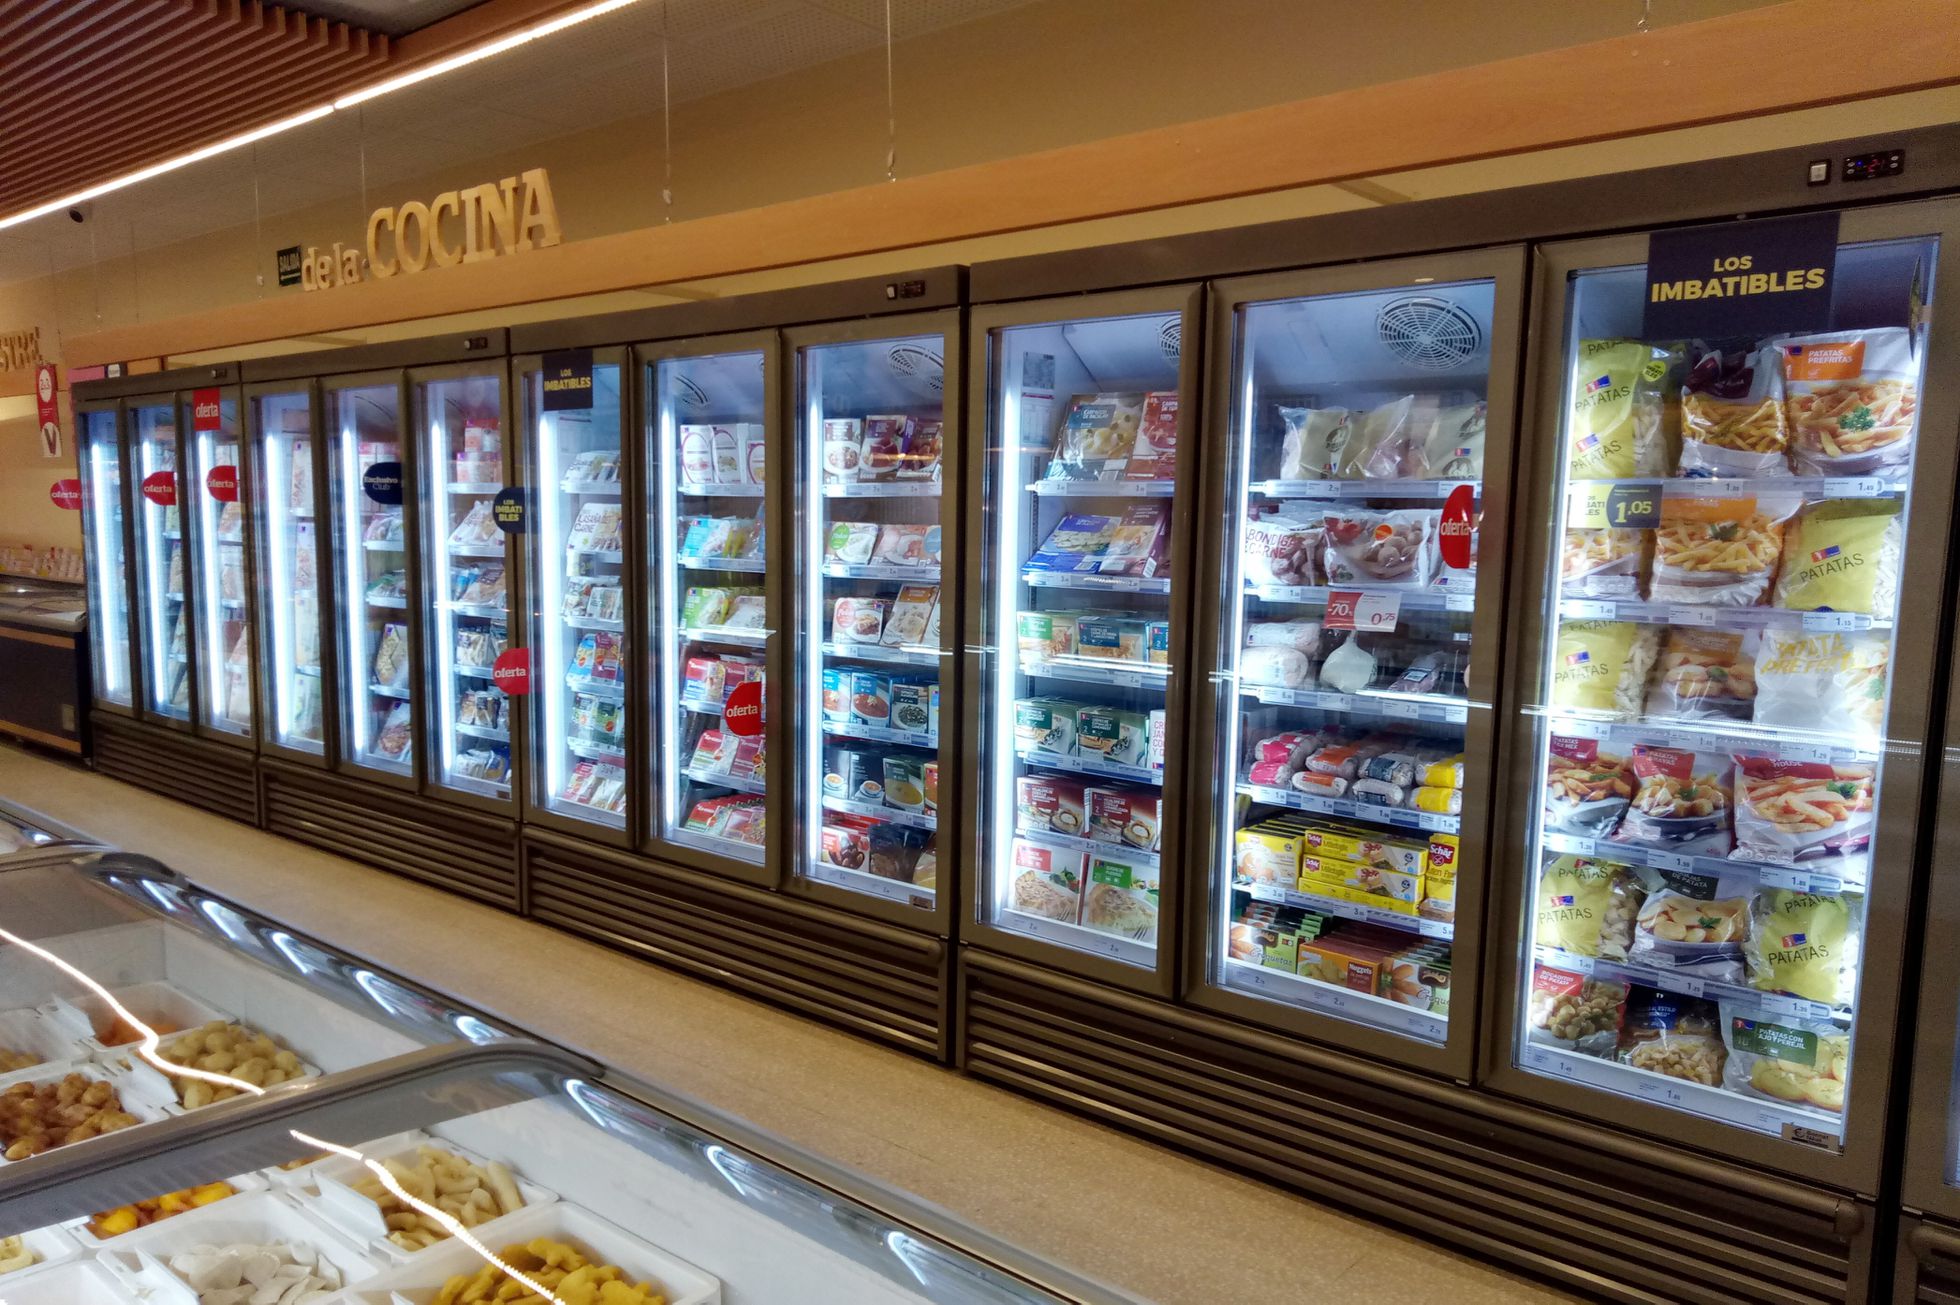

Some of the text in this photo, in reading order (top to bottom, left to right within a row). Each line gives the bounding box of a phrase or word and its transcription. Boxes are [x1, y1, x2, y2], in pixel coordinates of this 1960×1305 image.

[302, 168, 561, 291] de la COCINA
[1714, 256, 1752, 272] LOS
[1652, 268, 1825, 302] IMBATIBLES
[1808, 355, 1853, 364] PREFRITAS
[544, 377, 591, 391] IMBATIBLES
[1575, 386, 1630, 412] PATATAS
[195, 403, 218, 418] oferta
[1572, 440, 1622, 470] PATATAS
[144, 484, 172, 493] oferta
[207, 479, 234, 488] oferta
[52, 490, 78, 498] oferta
[495, 505, 522, 513] IMBATI
[1615, 500, 1652, 523] 1.05
[499, 513, 519, 521] BLES
[1440, 518, 1470, 536] oferta
[1801, 553, 1864, 582] PATATAS
[1371, 612, 1396, 625] 0.75
[495, 667, 526, 678] oferta
[1554, 663, 1609, 682] PATATAS
[726, 704, 758, 718] oferta
[1558, 866, 1609, 880] PATATAS
[1785, 894, 1836, 913] PATATAS
[1539, 907, 1593, 925] PATATAS
[1768, 944, 1830, 965] PATATAS
[1349, 963, 1373, 975] Nuggets
[1759, 1029, 1803, 1042] PATATAS CON
[1776, 1037, 1806, 1049] PEREJIL
